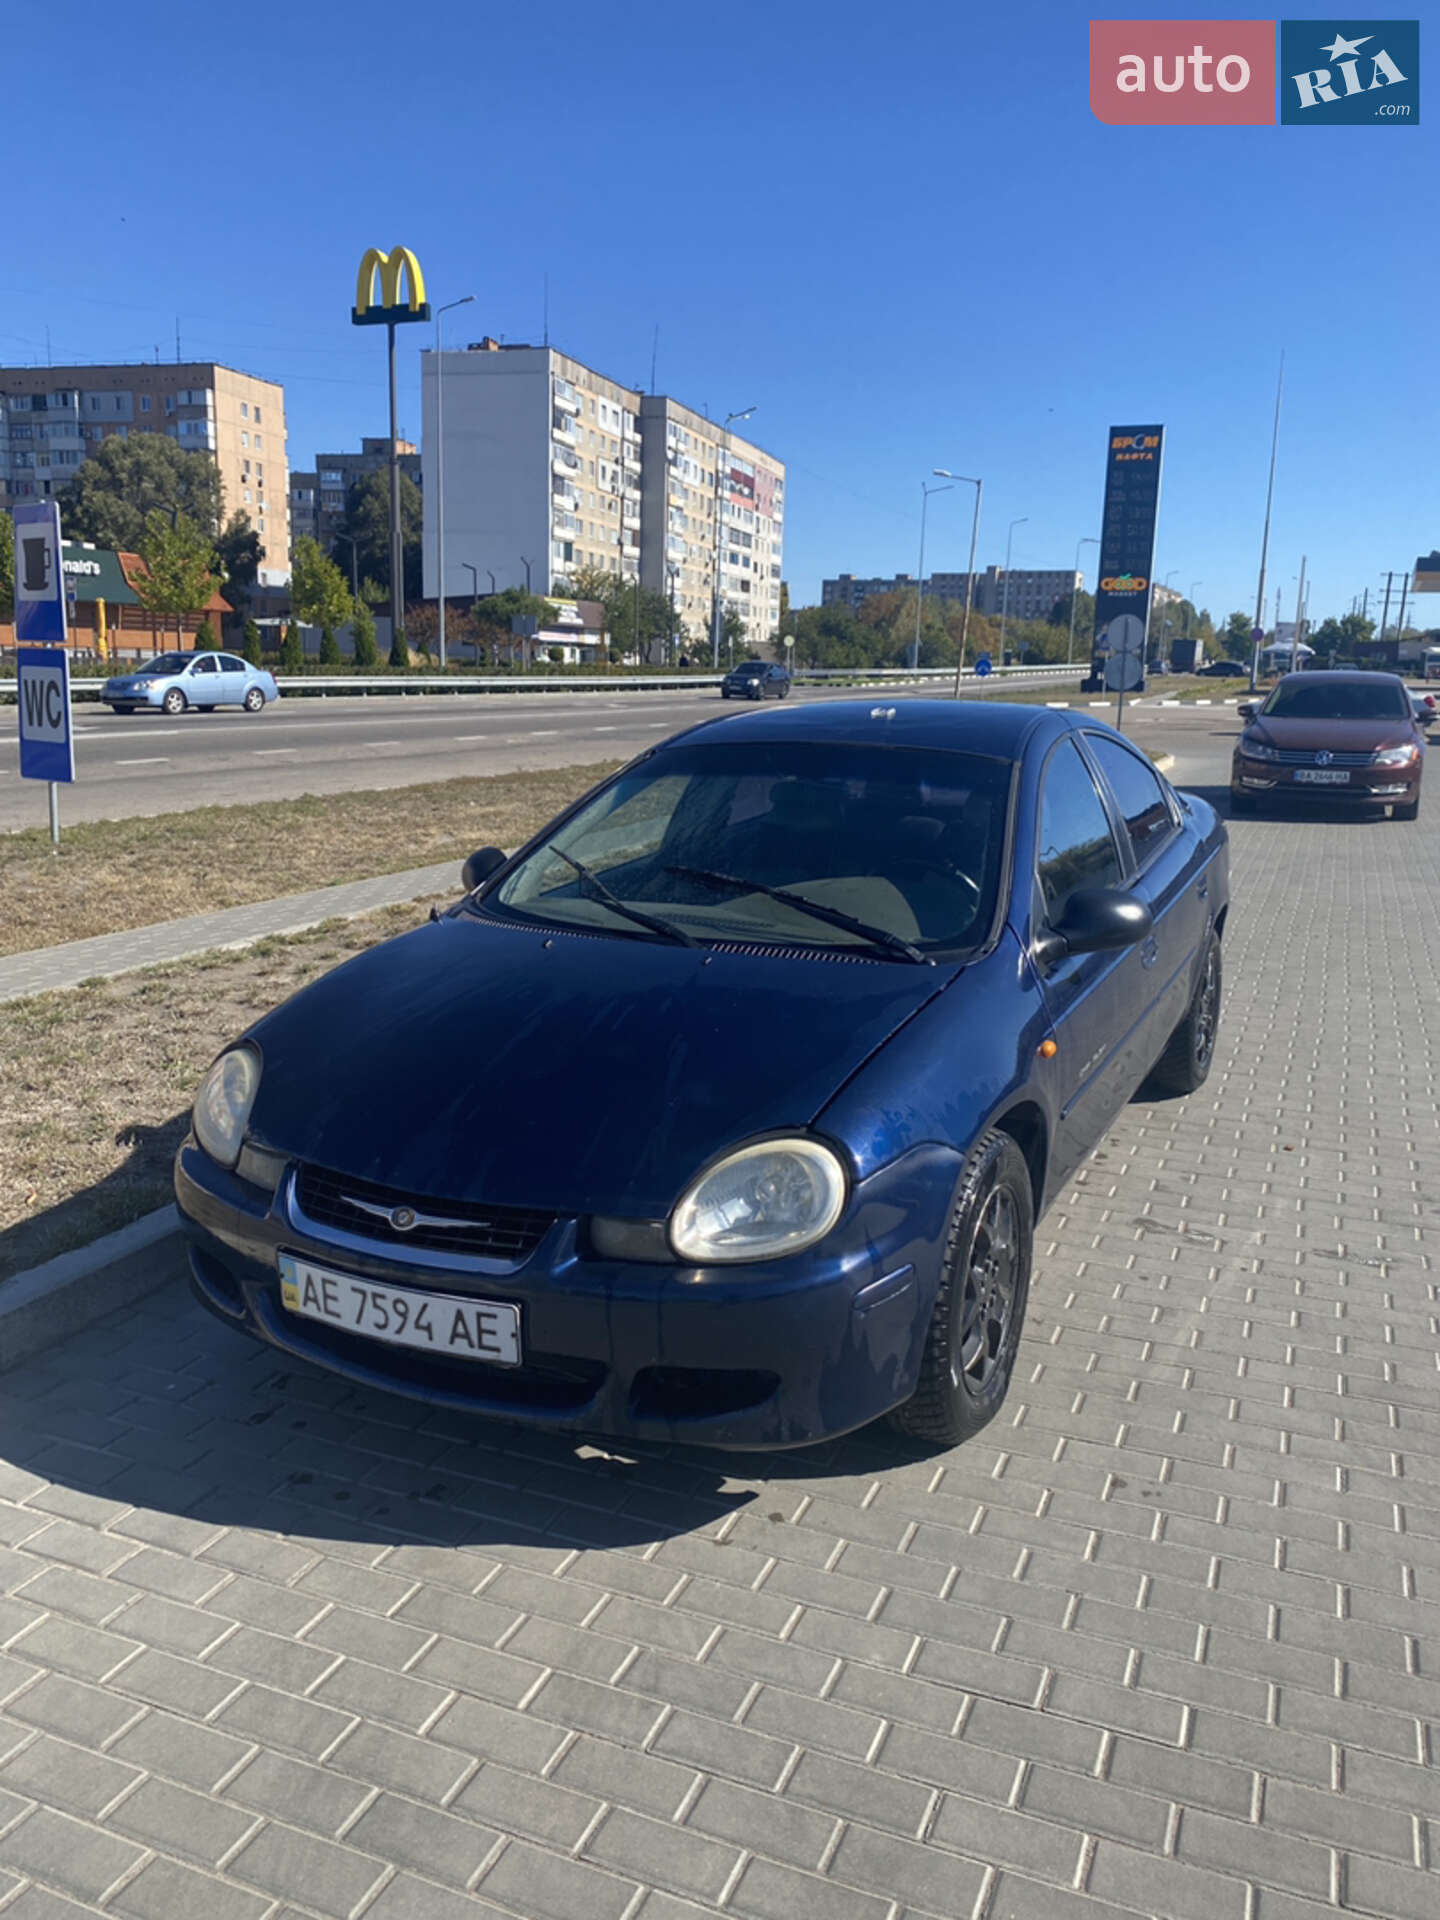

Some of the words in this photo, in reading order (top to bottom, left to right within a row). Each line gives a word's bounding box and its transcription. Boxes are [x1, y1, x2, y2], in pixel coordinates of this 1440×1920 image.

[24, 680, 62, 729] WC
[303, 1274, 342, 1319] AE
[350, 1286, 433, 1342] 7594
[449, 1308, 502, 1353] AE
